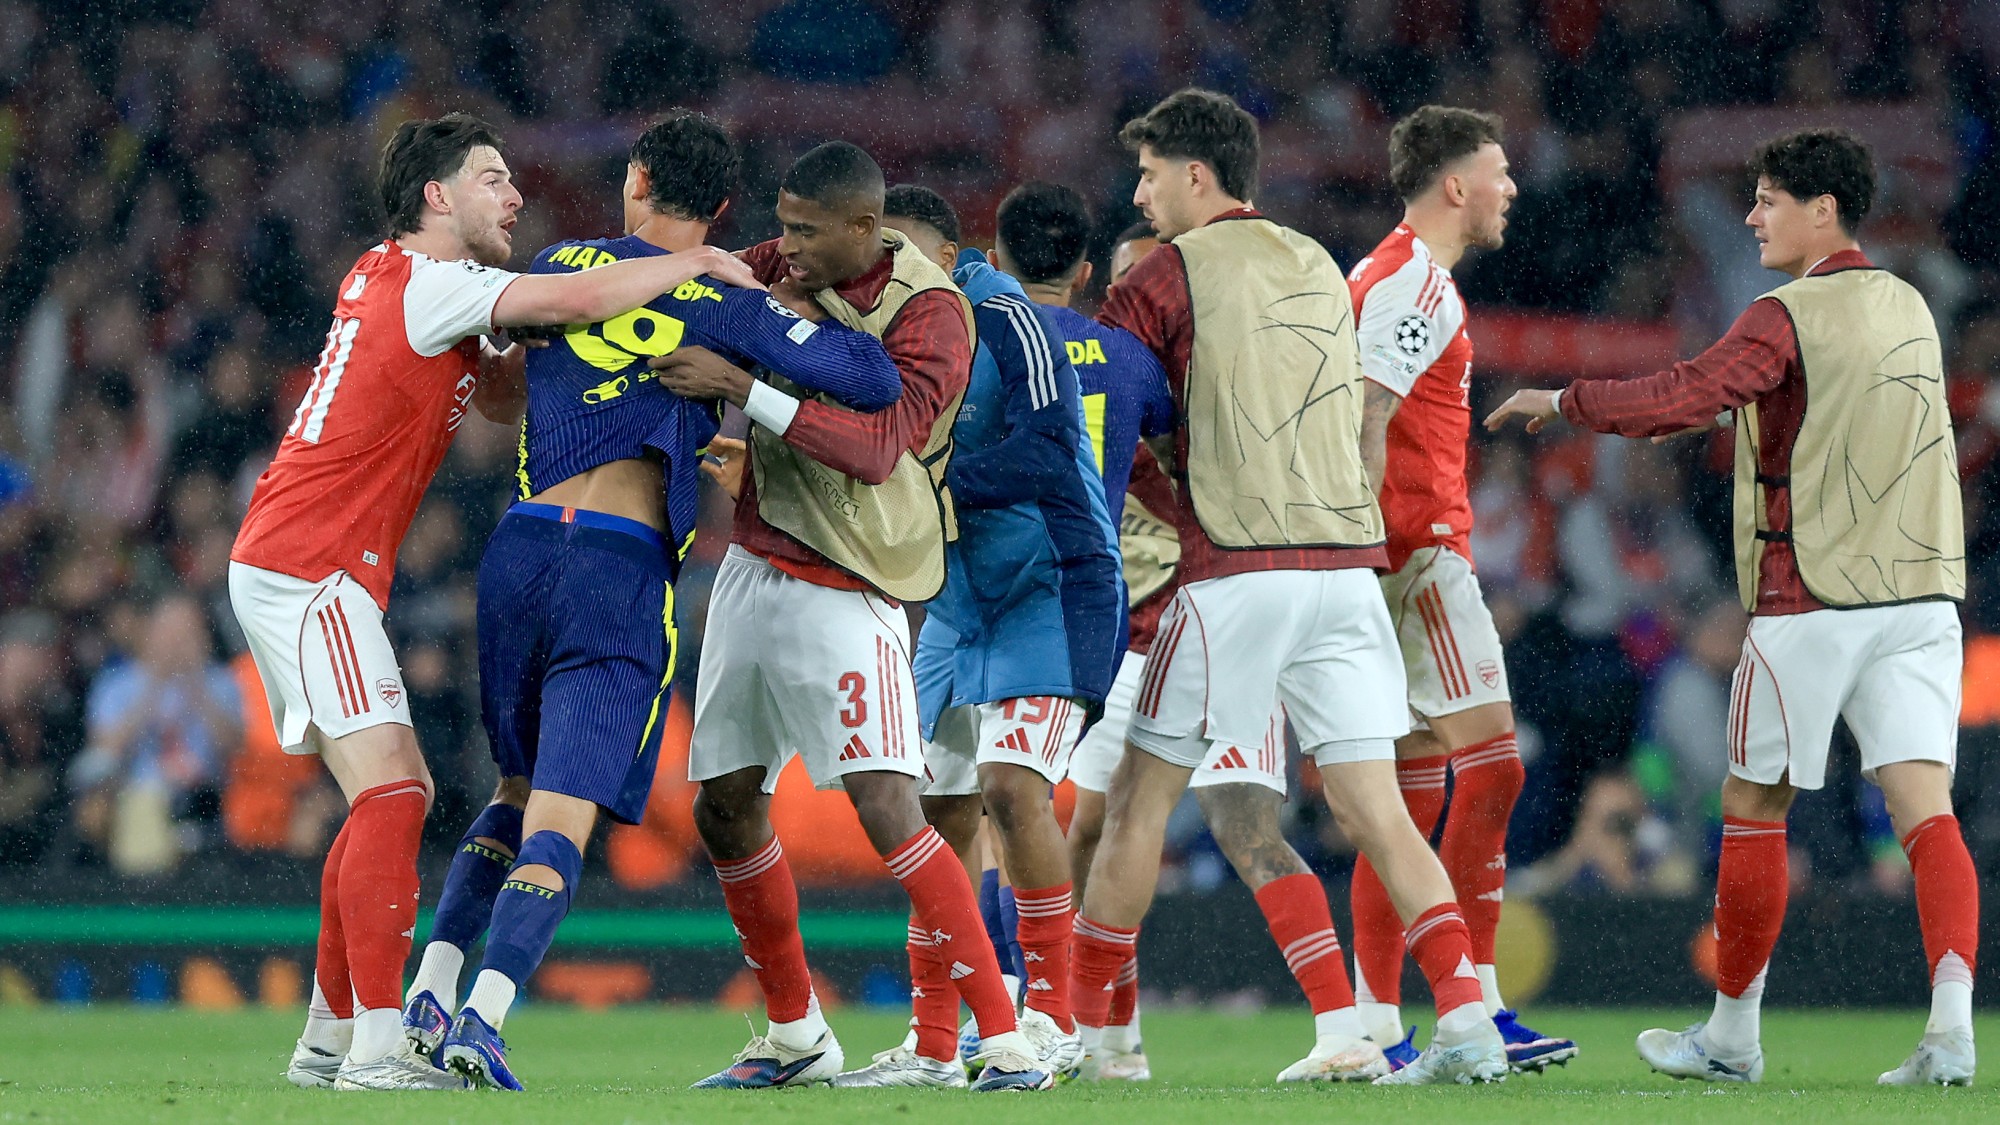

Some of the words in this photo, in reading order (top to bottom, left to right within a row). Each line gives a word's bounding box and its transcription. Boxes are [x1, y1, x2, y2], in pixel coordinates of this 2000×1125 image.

[1064, 339, 1107, 365] DA
[809, 467, 860, 519] RESPECT
[838, 671, 868, 729] 3
[462, 843, 515, 869] ATLET
[500, 881, 555, 900] ATLETI
